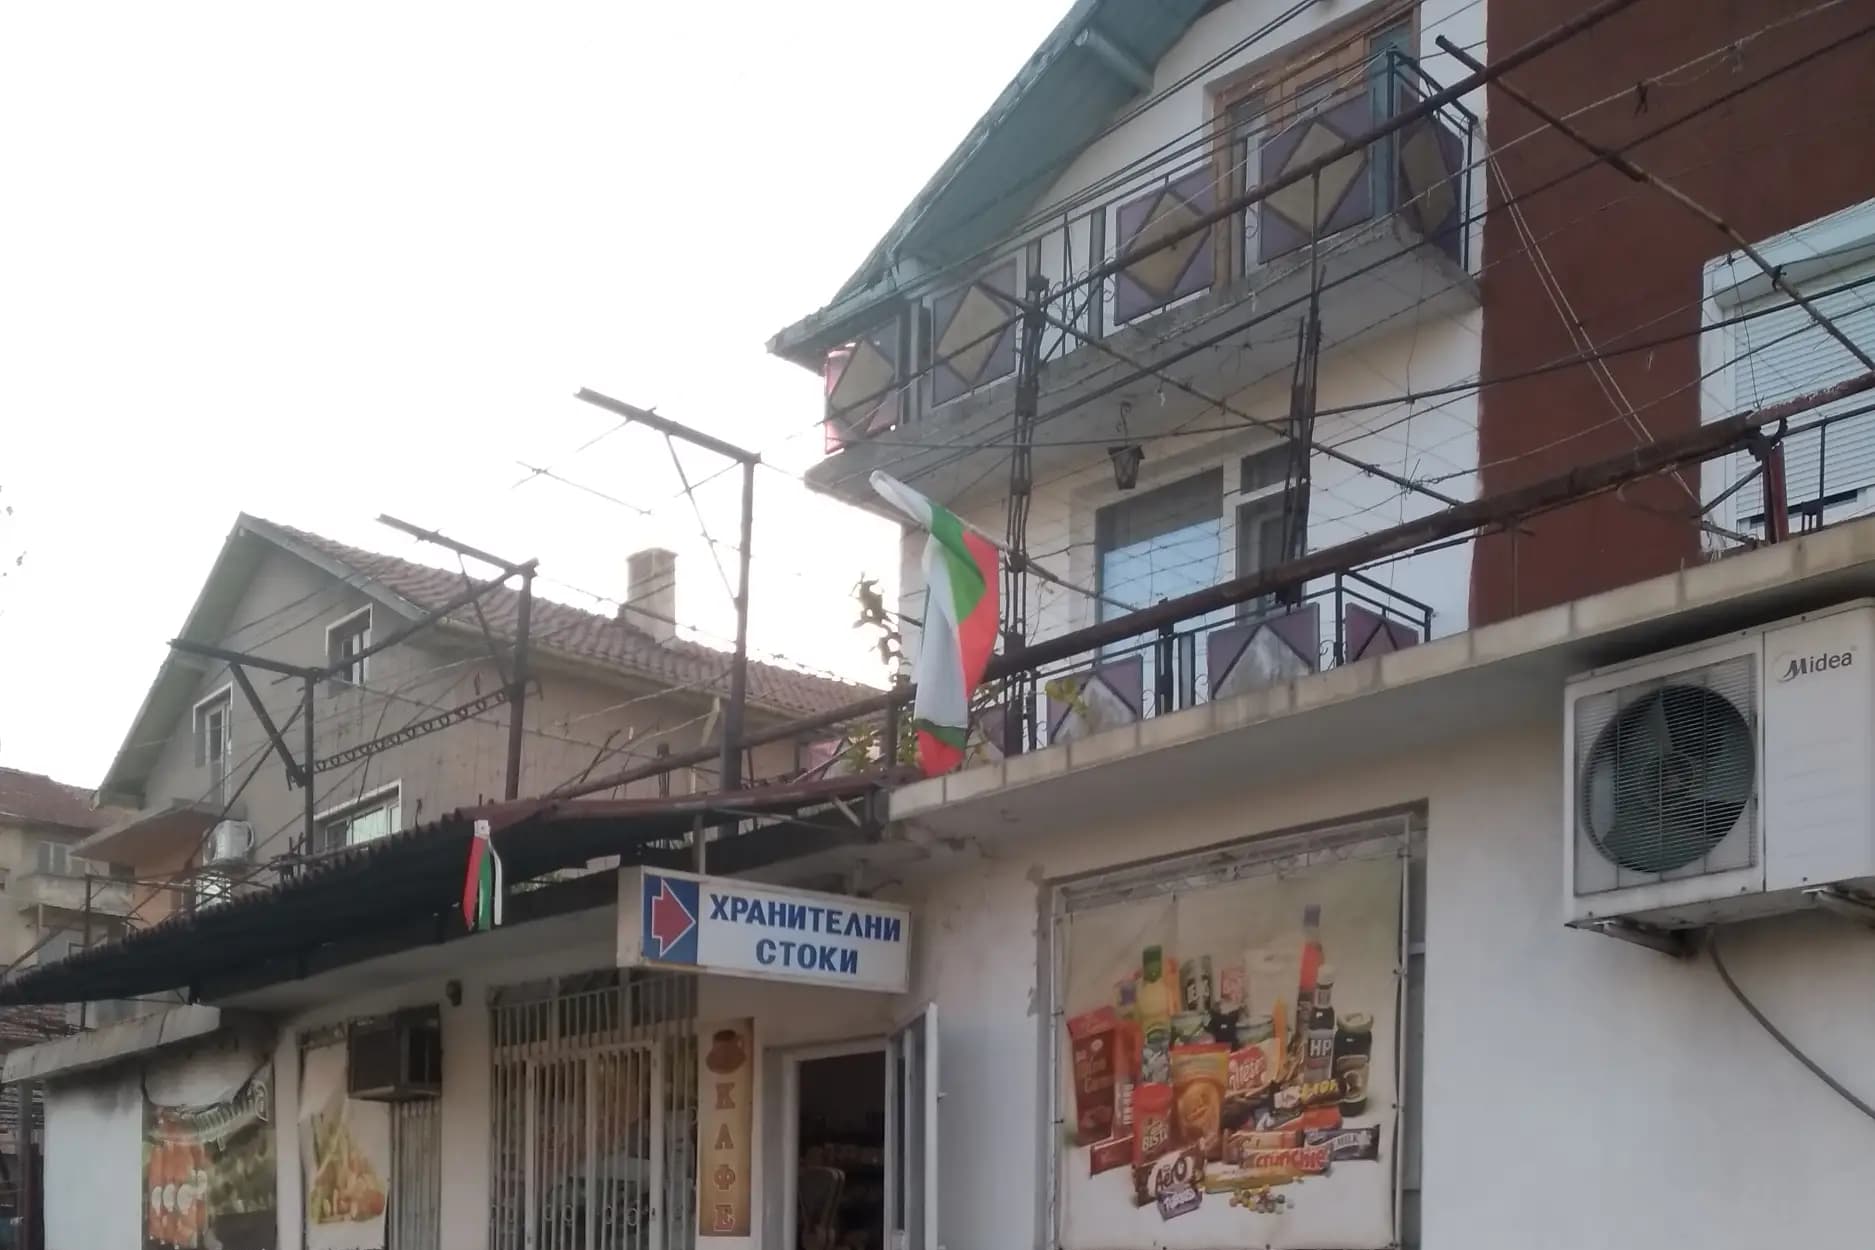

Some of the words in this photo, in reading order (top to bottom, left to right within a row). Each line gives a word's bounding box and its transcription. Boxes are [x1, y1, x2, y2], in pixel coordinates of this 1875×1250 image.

[1783, 652, 1853, 682] Midea
[709, 893, 901, 943] ХРАНИТЕЛНИ
[755, 938, 858, 975] СТОКИ
[1309, 1039, 1332, 1057] HP
[714, 1082, 736, 1232] КАФЕ
